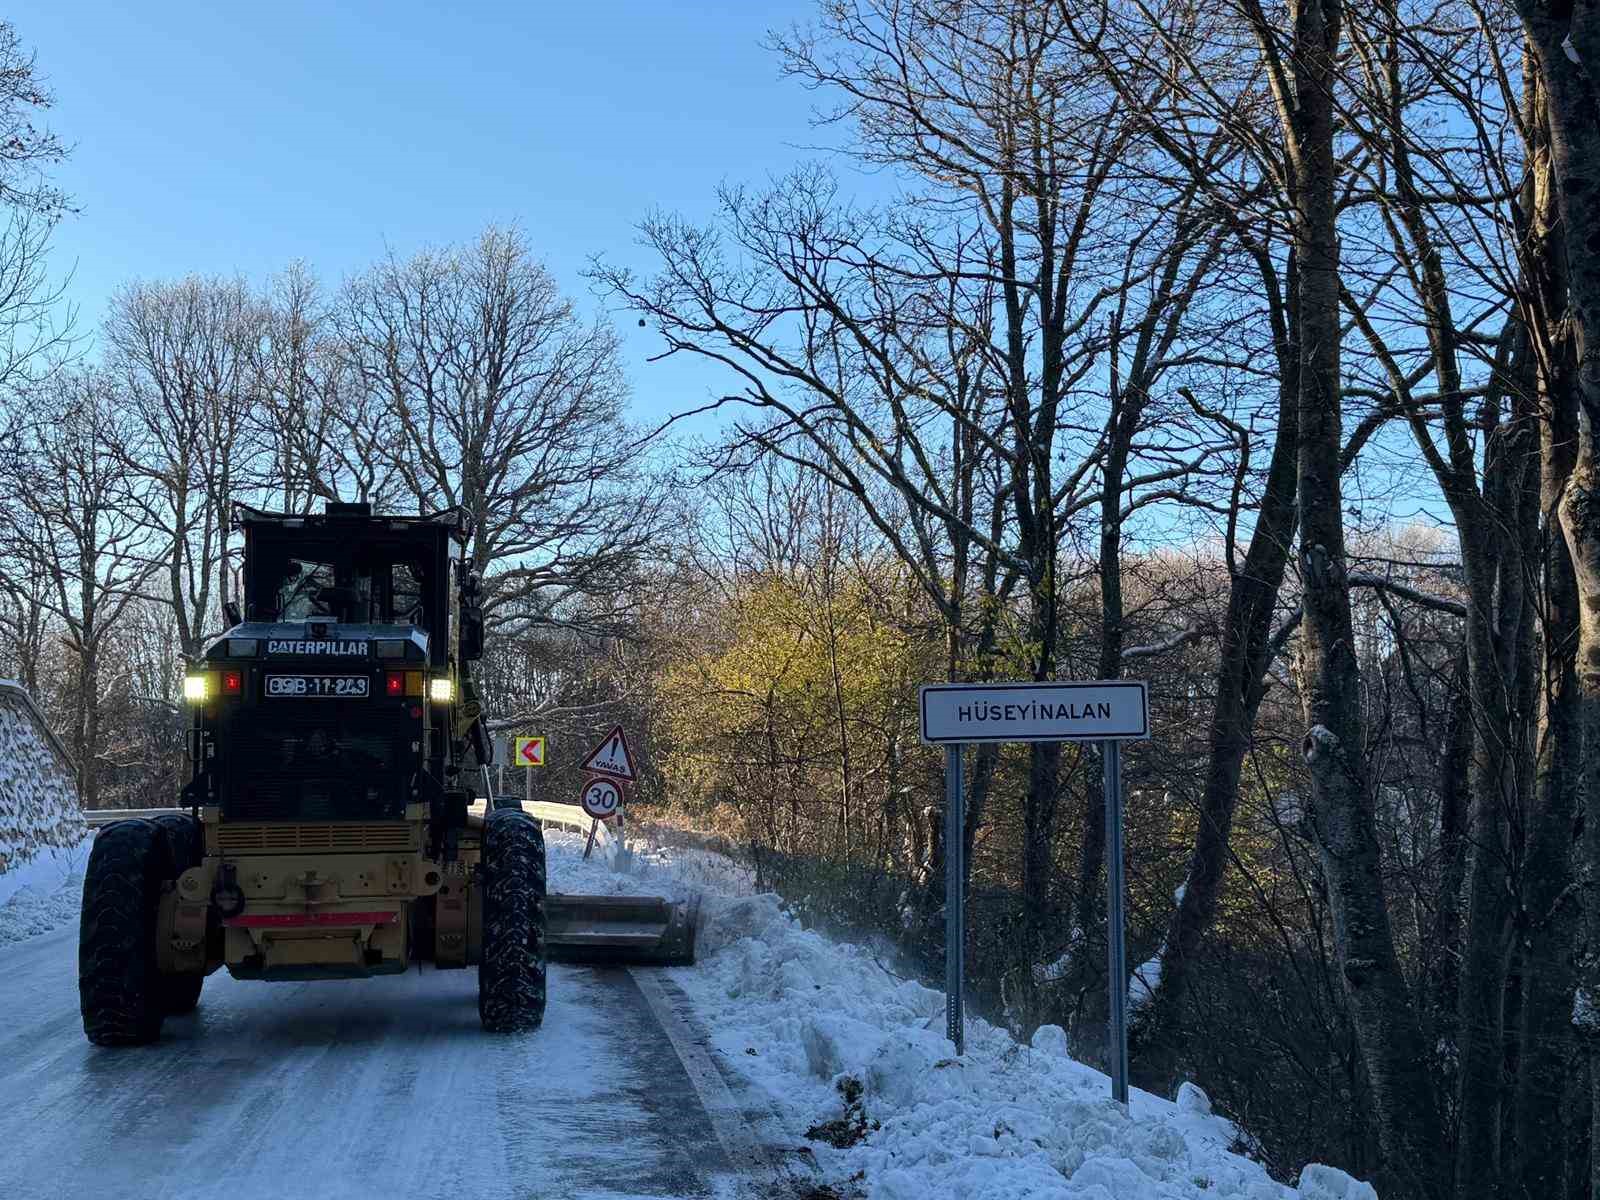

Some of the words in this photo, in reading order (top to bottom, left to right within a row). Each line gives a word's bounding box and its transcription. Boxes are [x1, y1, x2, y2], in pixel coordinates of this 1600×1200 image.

[268, 640, 368, 655] CATERPILLAR
[958, 700, 1111, 722] HÜSEYİNALAN
[588, 787, 615, 809] 30
